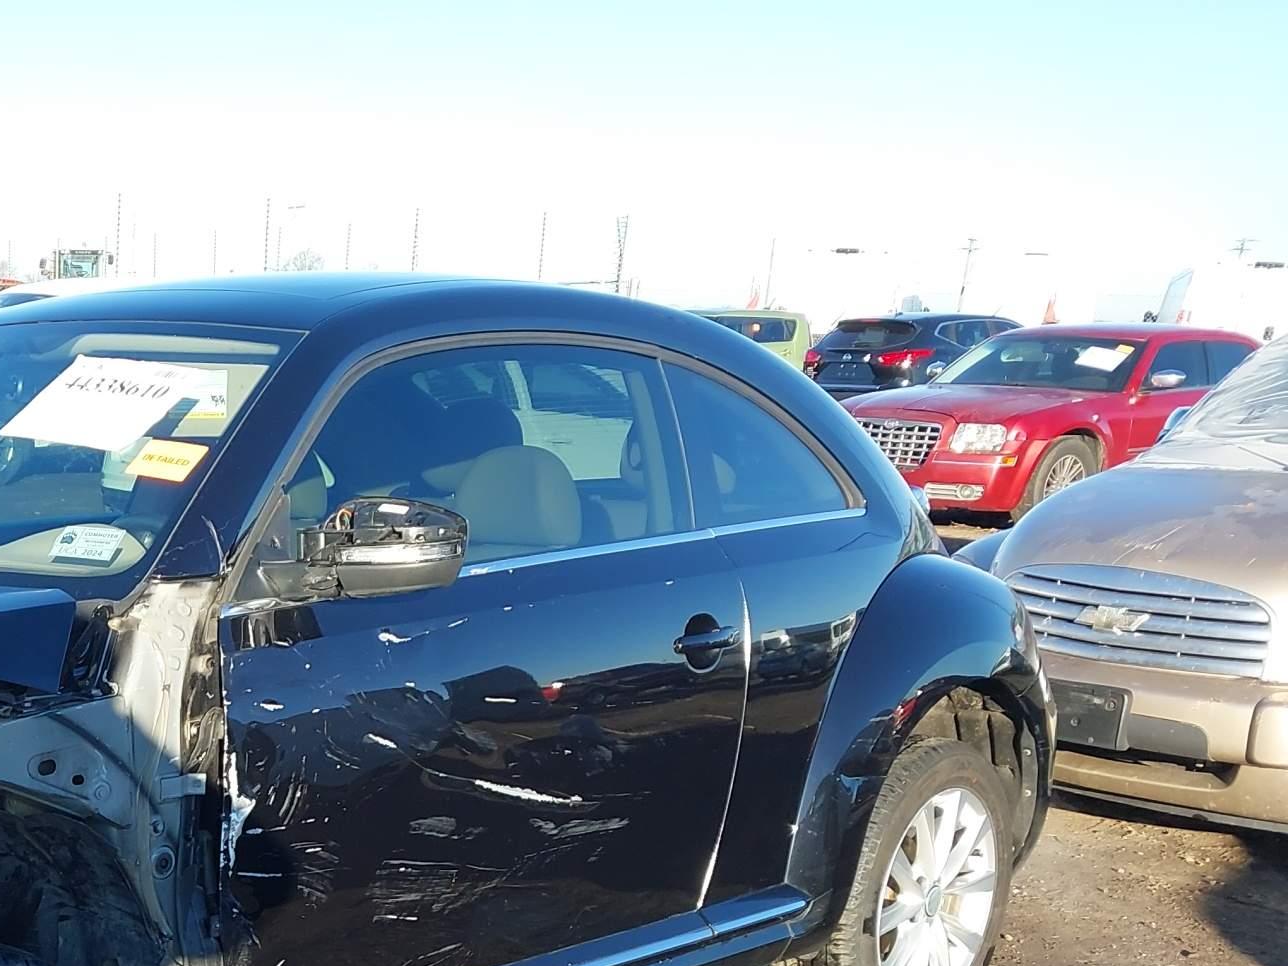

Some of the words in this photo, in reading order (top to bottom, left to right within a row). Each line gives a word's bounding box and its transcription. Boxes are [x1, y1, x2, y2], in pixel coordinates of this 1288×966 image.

[65, 375, 170, 399] 44338610
[141, 453, 191, 466] DETAILED
[81, 549, 103, 557] 2024
